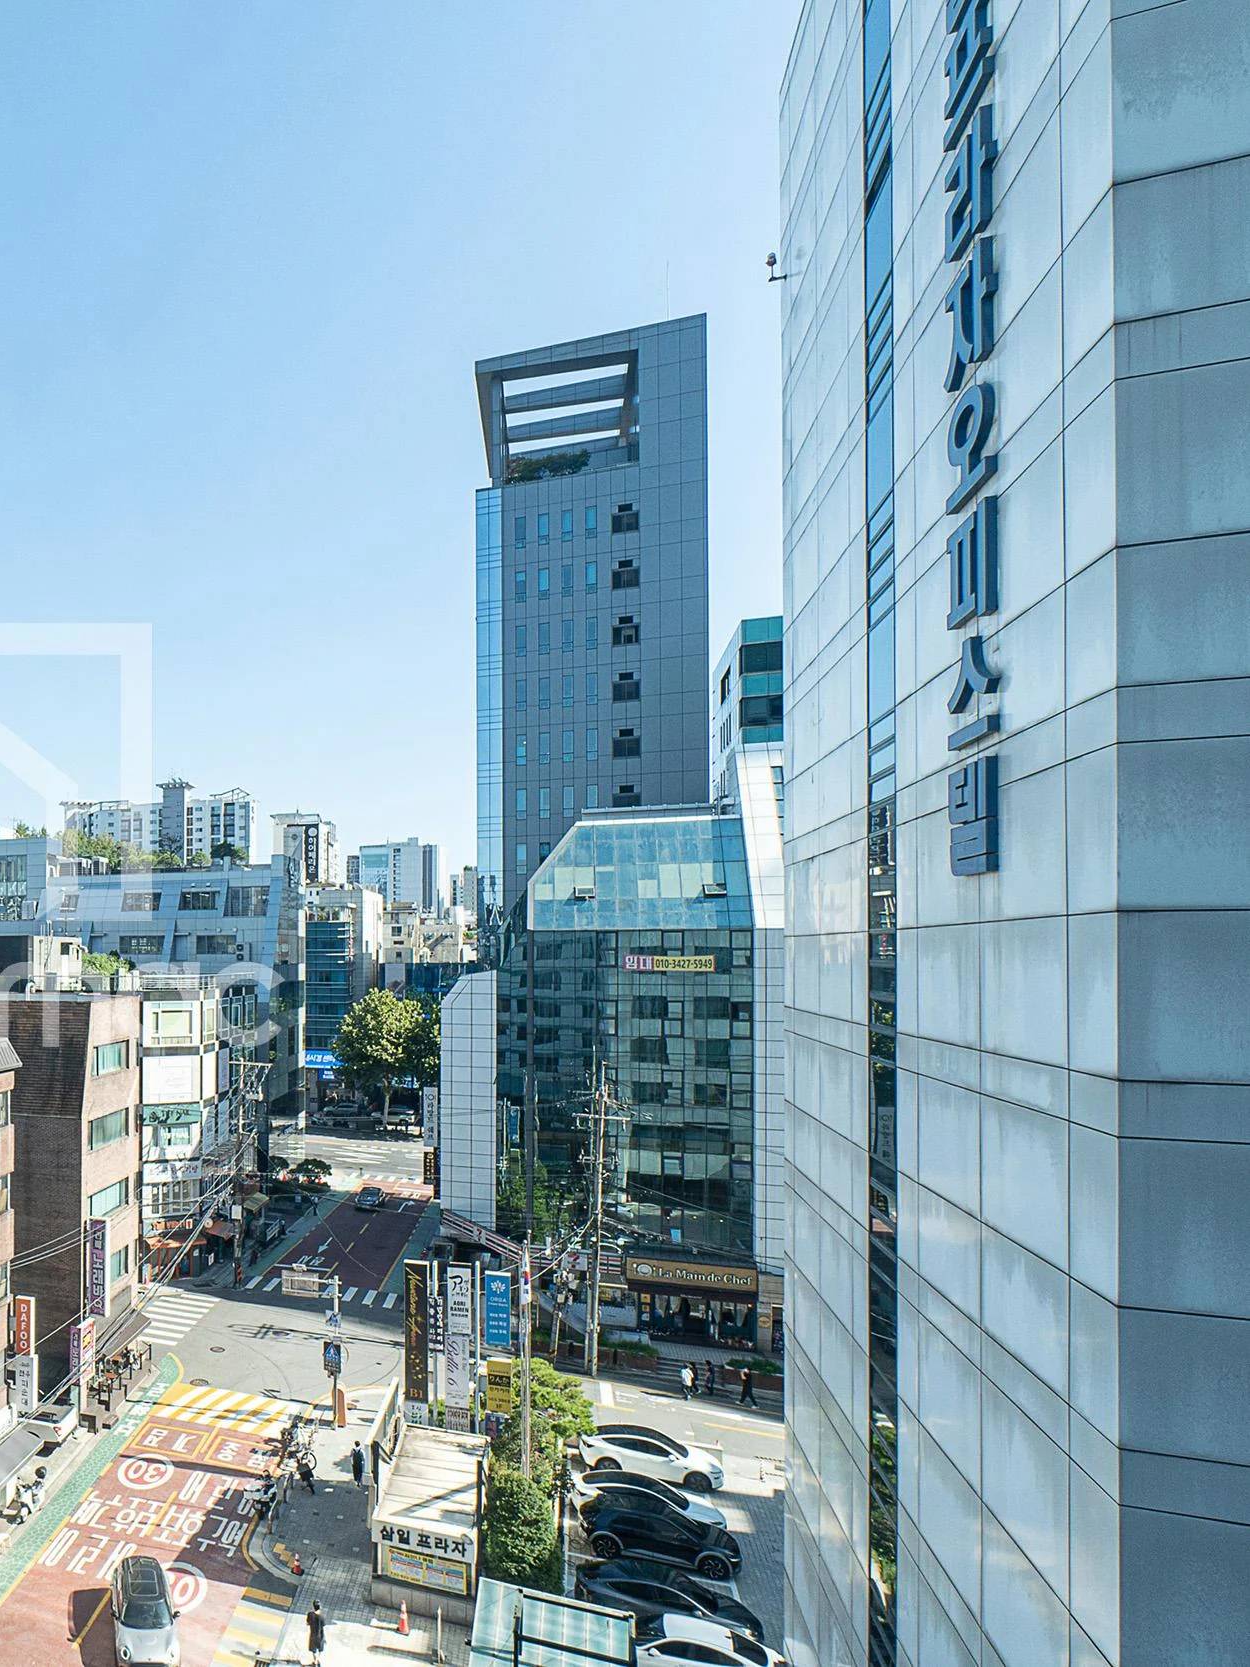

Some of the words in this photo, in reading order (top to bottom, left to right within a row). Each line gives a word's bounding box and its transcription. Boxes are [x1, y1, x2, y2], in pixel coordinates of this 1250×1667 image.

[943, 0, 1000, 877] 프라자오피스텔
[655, 958, 713, 969] 010-3427-5949
[676, 1269, 706, 1281] Main
[707, 1274, 721, 1283] de
[723, 1274, 753, 1286] Chef
[20, 1304, 28, 1349] DAFOO
[129, 1459, 164, 1482] 30
[70, 1490, 166, 1538] 보호구역
[152, 1504, 248, 1558] 보호구역
[37, 1527, 137, 1581] 어린이
[380, 1525, 411, 1545] 삼일
[416, 1532, 467, 1558] 프라자
